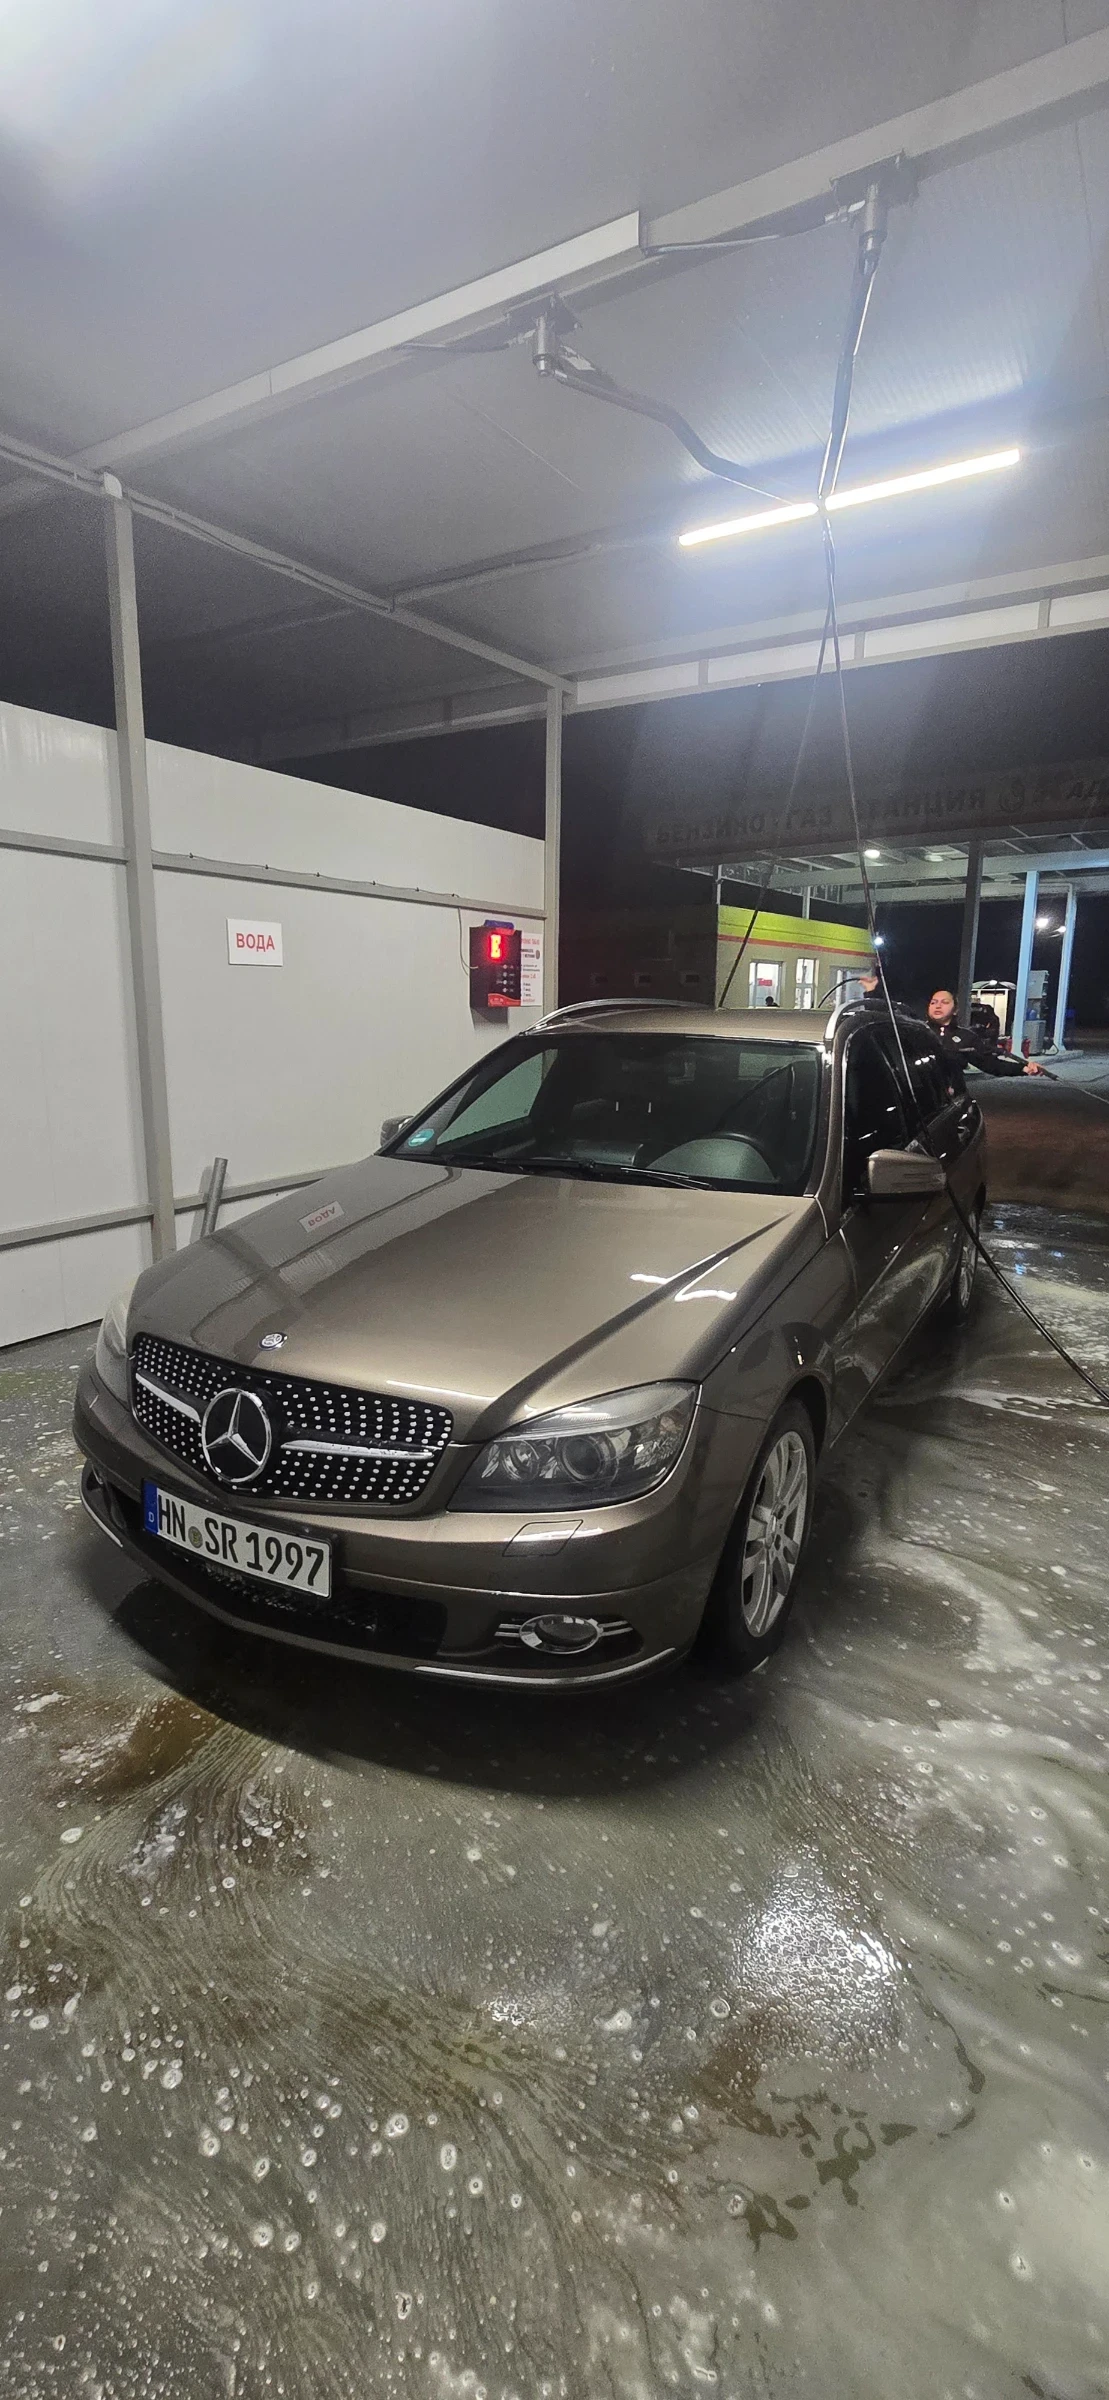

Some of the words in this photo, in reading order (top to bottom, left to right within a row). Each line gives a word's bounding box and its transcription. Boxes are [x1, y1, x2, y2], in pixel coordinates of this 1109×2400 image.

[786, 804, 832, 831] ГАЗ
[236, 932, 275, 952] ВОДА
[148, 1511, 155, 1523] D
[157, 1494, 186, 1542] HN
[204, 1517, 239, 1564] SR
[245, 1531, 324, 1587] 1997
